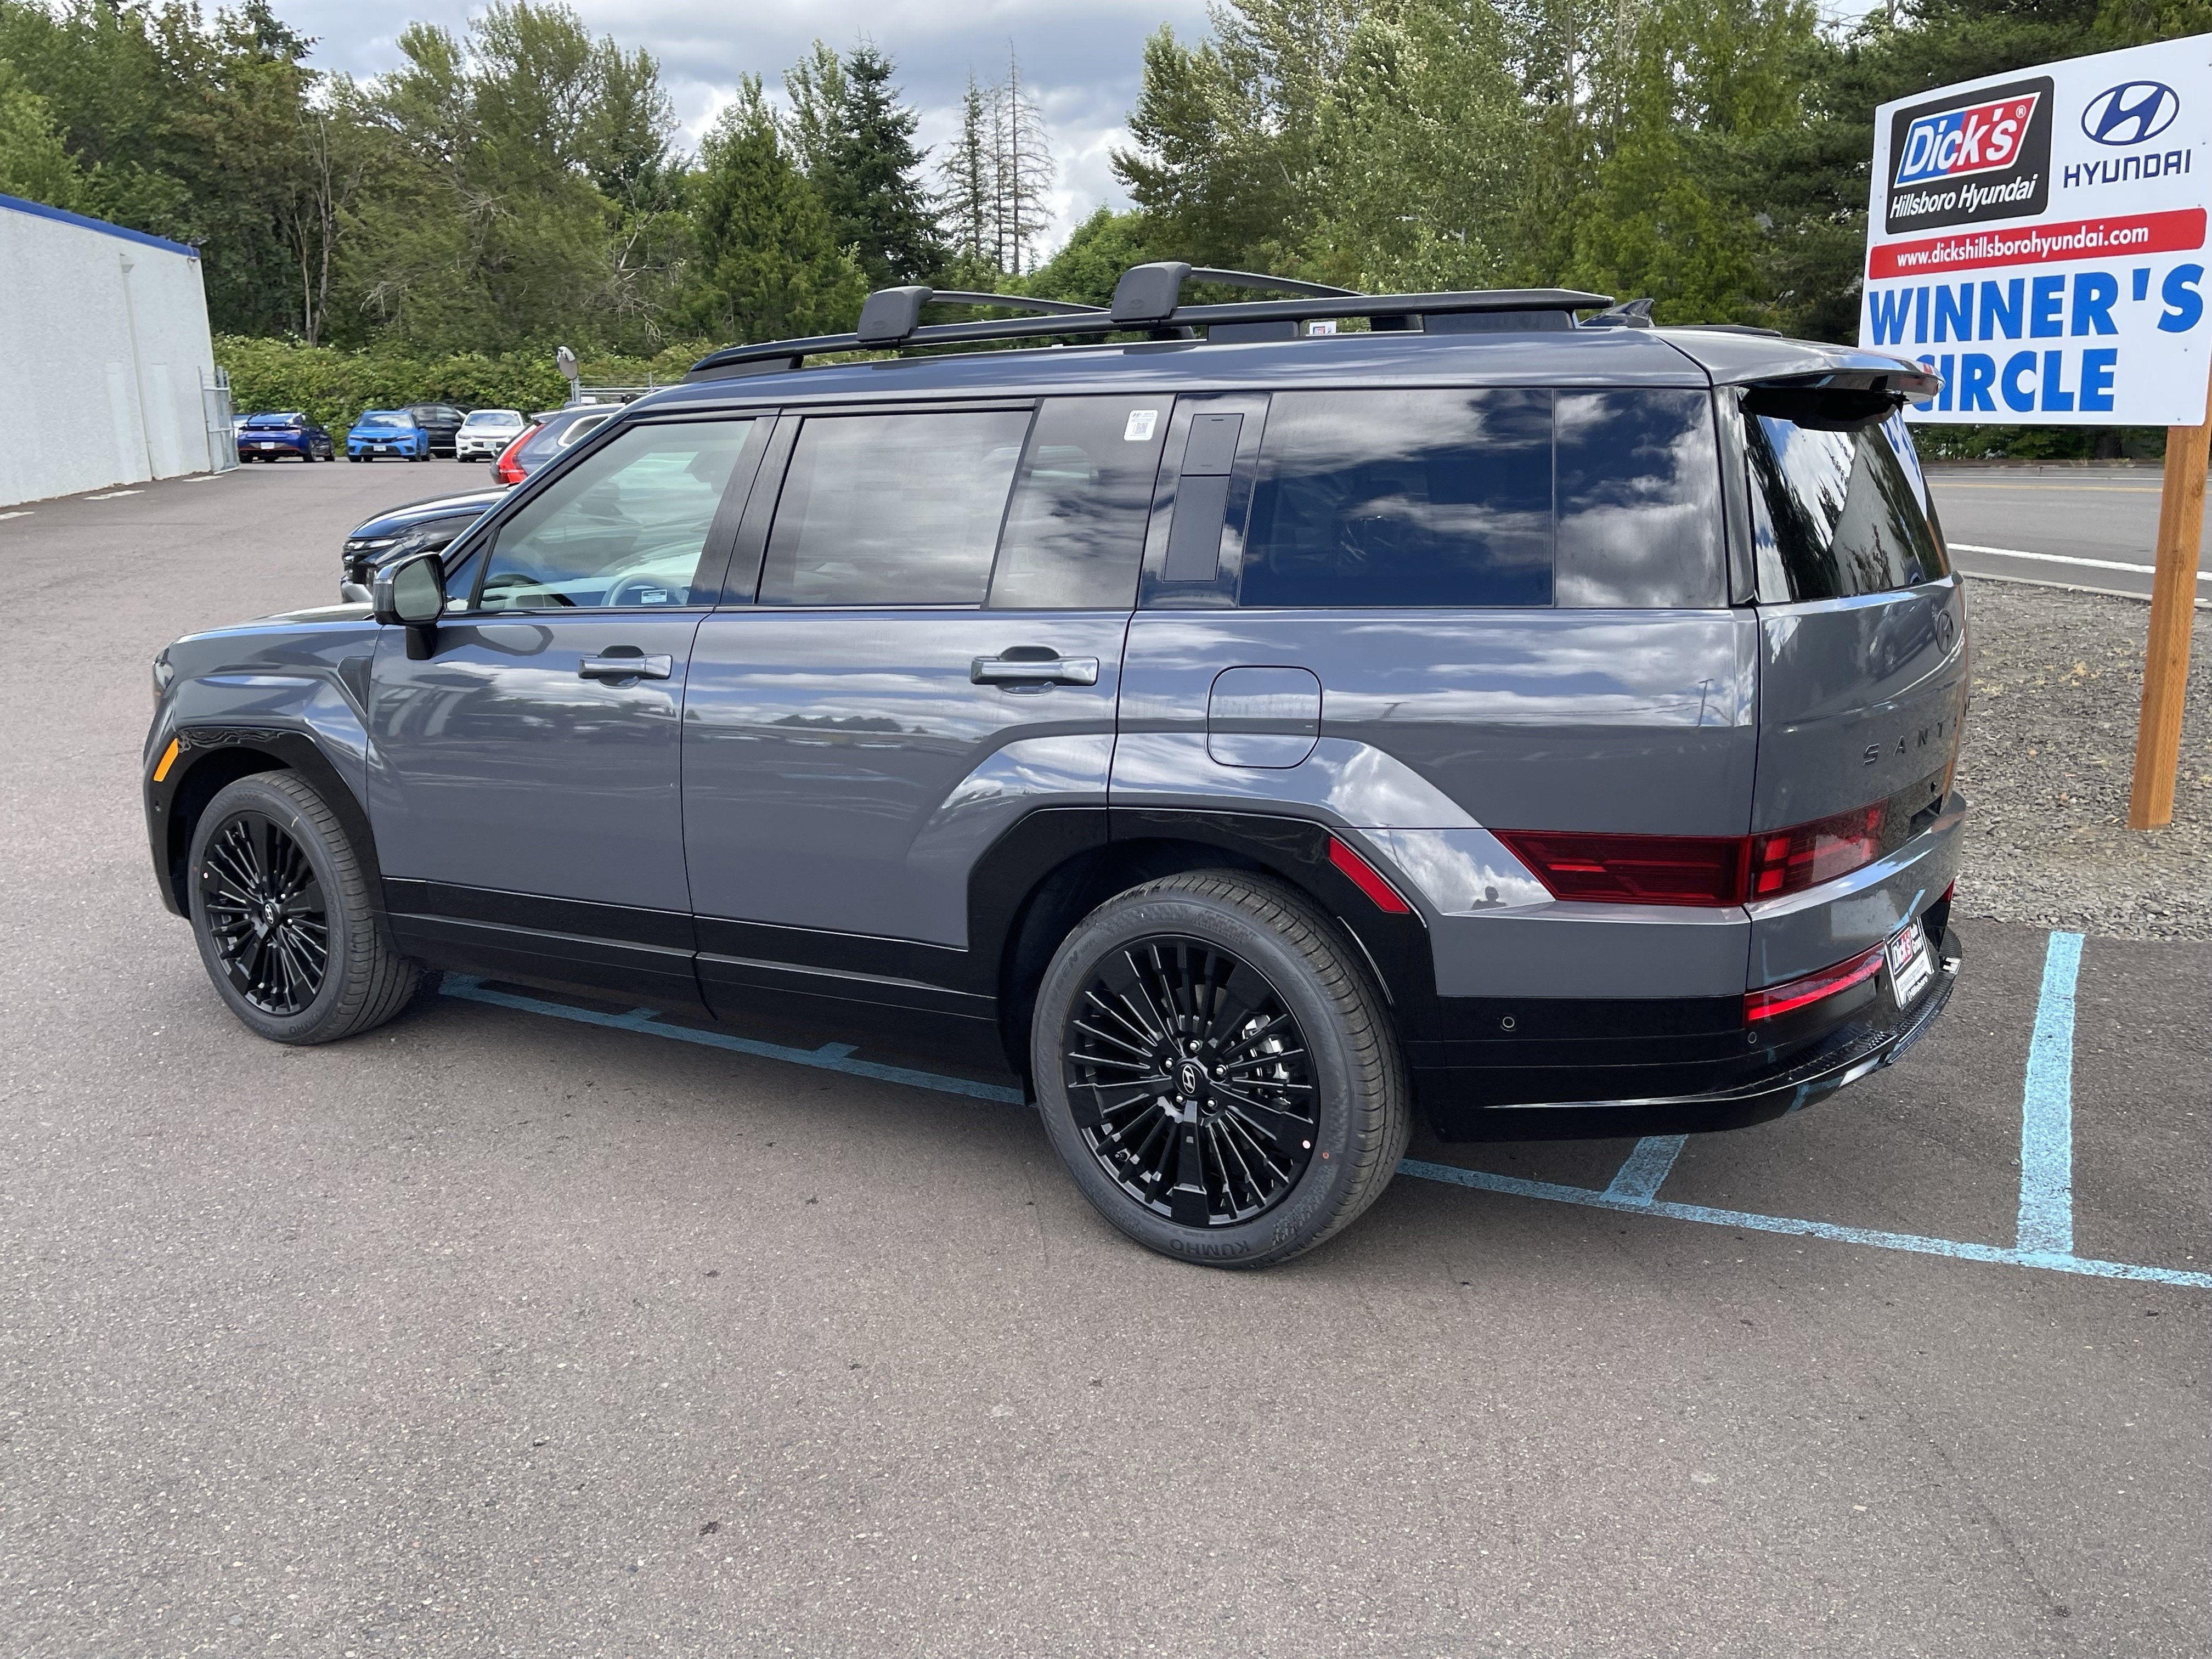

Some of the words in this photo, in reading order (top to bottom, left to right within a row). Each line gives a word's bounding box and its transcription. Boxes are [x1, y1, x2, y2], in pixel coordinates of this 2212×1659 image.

[2063, 149, 2191, 188] HYUNDAI
[1889, 191, 1956, 219] Hillsboro
[1957, 173, 2039, 213] Hyundai
[1897, 224, 2149, 267] www.dickshillsborohyundai.com
[1869, 263, 2205, 346] WINNER'S
[1169, 1239, 1251, 1257] KUMHO
